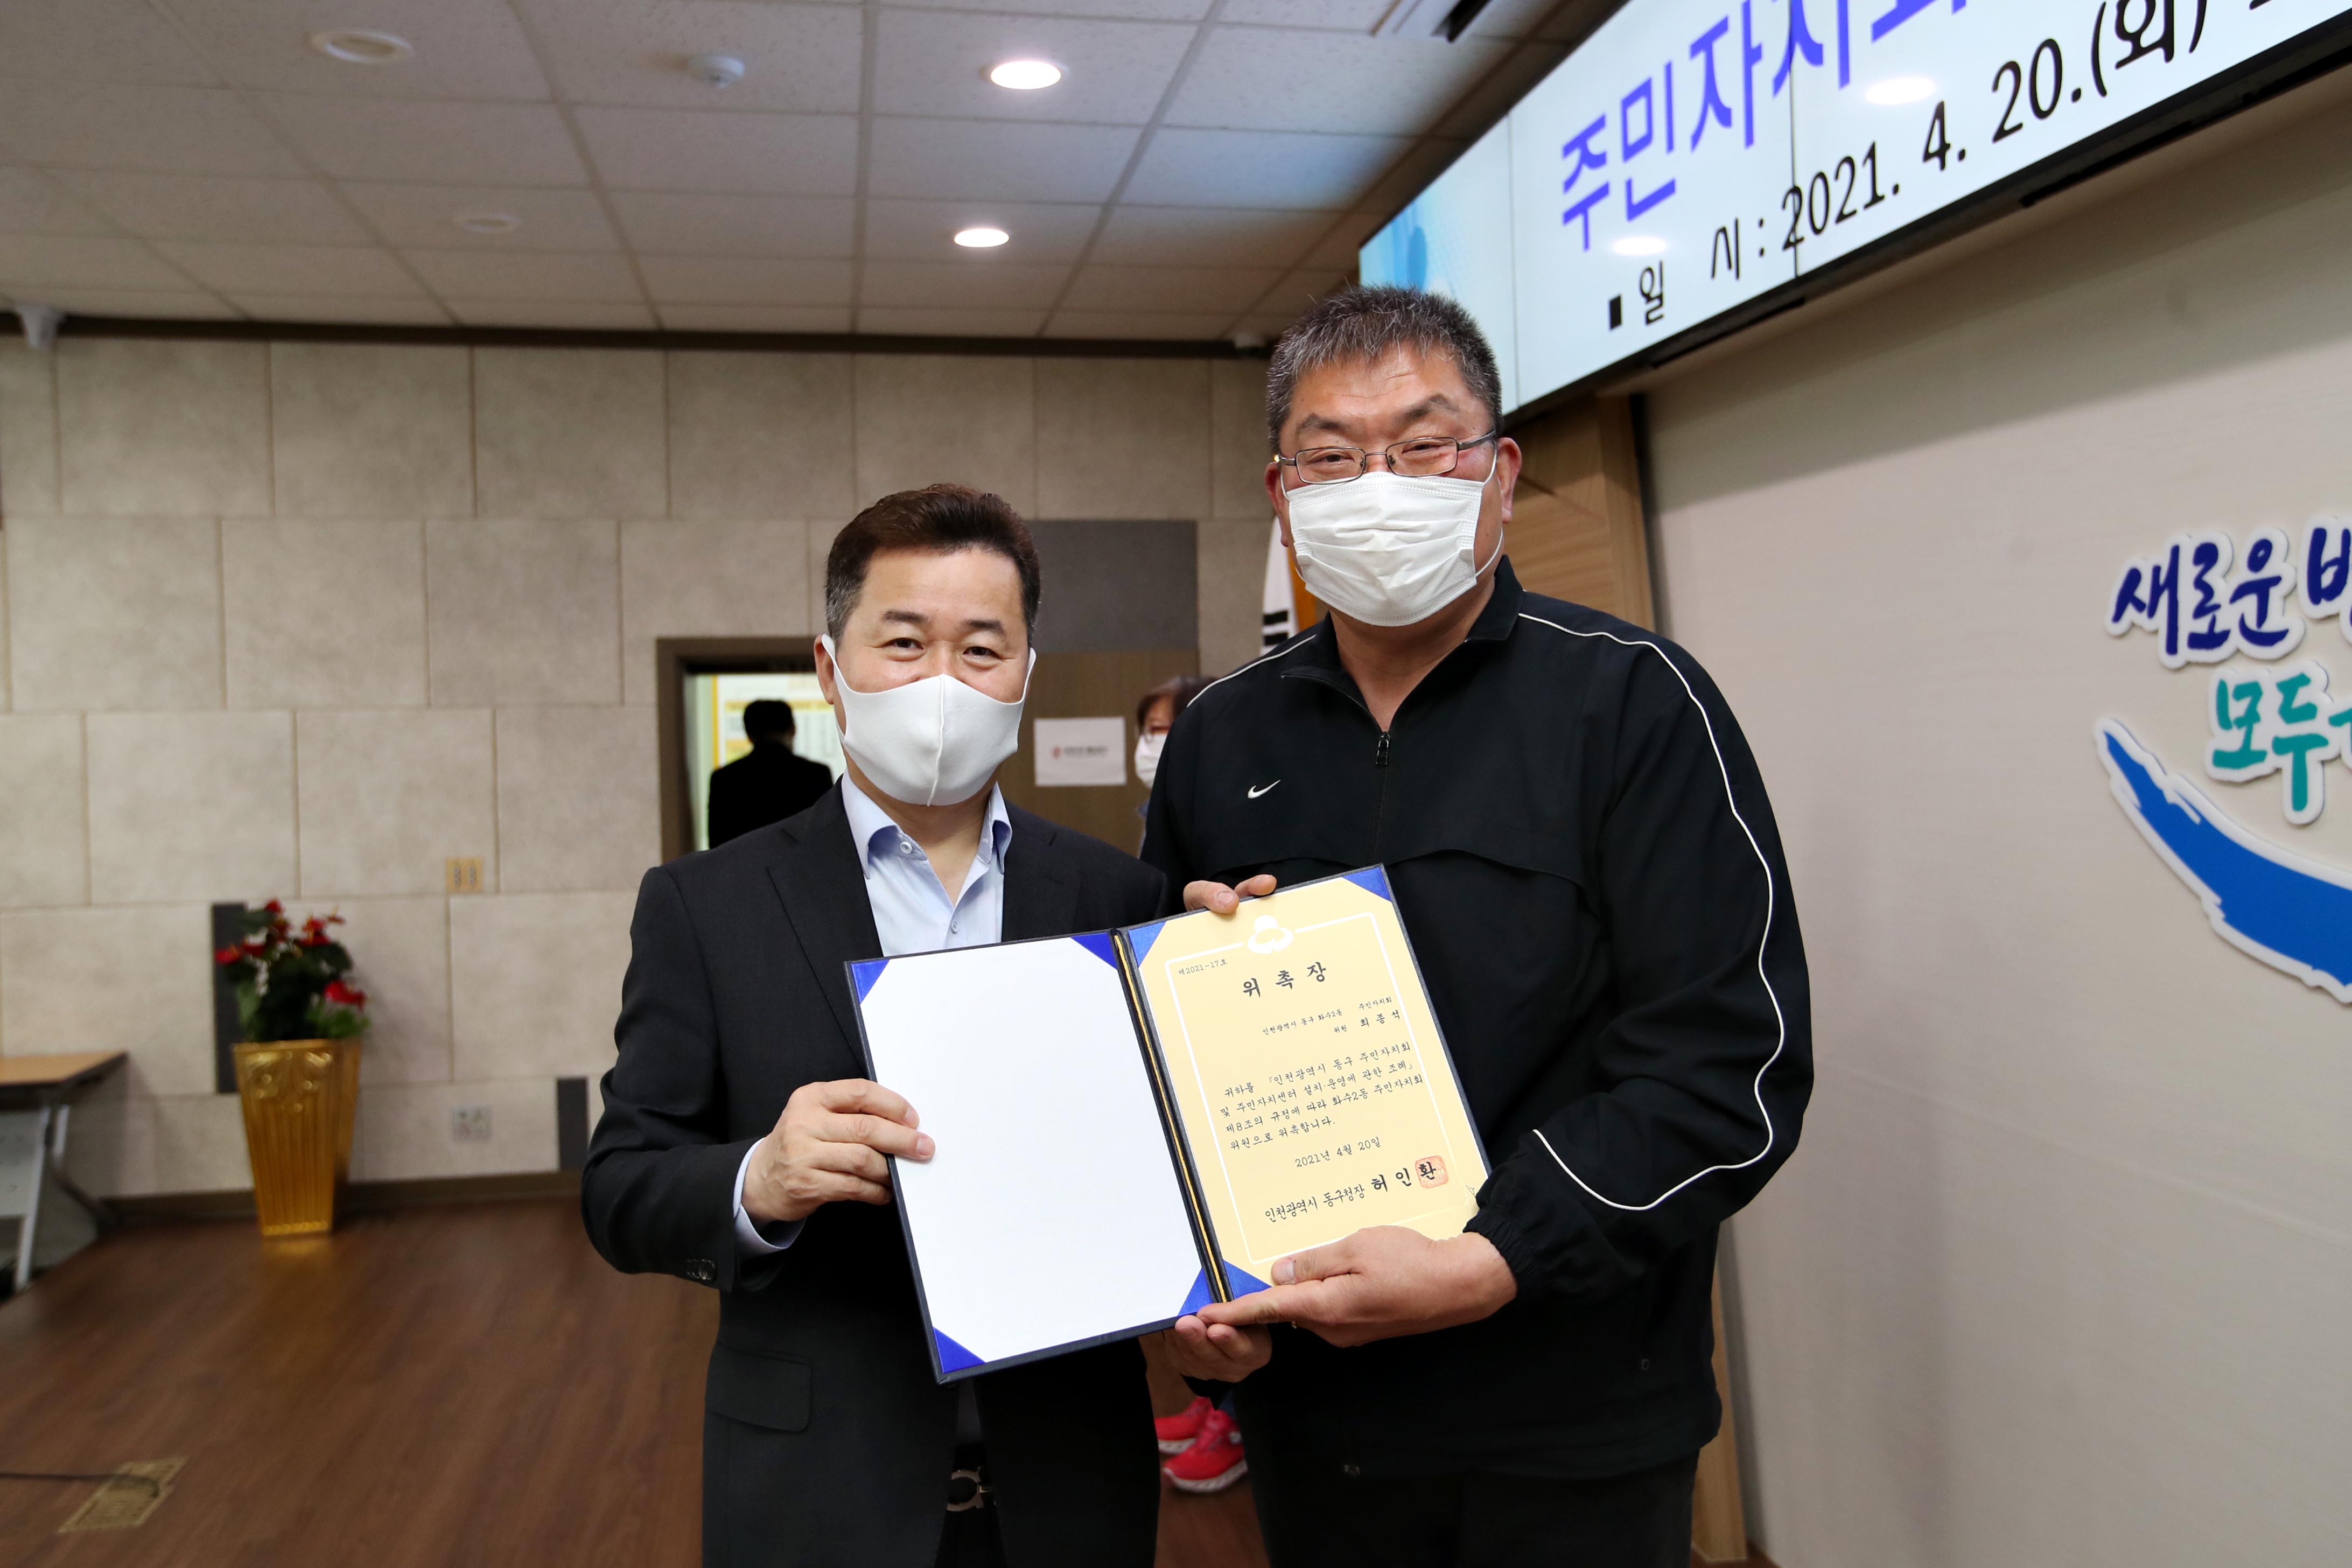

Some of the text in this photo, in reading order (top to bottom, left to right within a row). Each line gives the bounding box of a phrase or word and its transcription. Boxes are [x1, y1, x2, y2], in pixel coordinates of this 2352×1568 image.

[1563, 0, 1966, 252] 주민자
[1639, 260, 1664, 325] 일
[1782, 141, 1900, 251] 2021.
[1922, 101, 1966, 172] 4.
[2112, 538, 2289, 656] 새로운
[1262, 1020, 1297, 1035] 인천광역시
[1301, 1016, 1314, 1026] 동구
[1358, 996, 1392, 1010] 주민자치회
[1333, 1025, 1347, 1033] 위원
[1220, 1107, 1231, 1118] 및
[1236, 1089, 1297, 1113] 주민자치센터
[1362, 1066, 1382, 1081] 관한
[1224, 1082, 1254, 1098] 귀하를
[1333, 1056, 1353, 1070] 동구
[1359, 1041, 1411, 1063] 주민자치회
[1226, 1073, 1423, 1133] 제8조의 규정에 따라 화수2동 주민자치회
[1230, 1116, 1336, 1150] 위원으로 위촉합니다.
[1295, 1136, 1381, 1168] 2021년 4월 20일
[1265, 1196, 1318, 1223] 인천광역시
[1322, 1184, 1365, 1207] 동구청장
